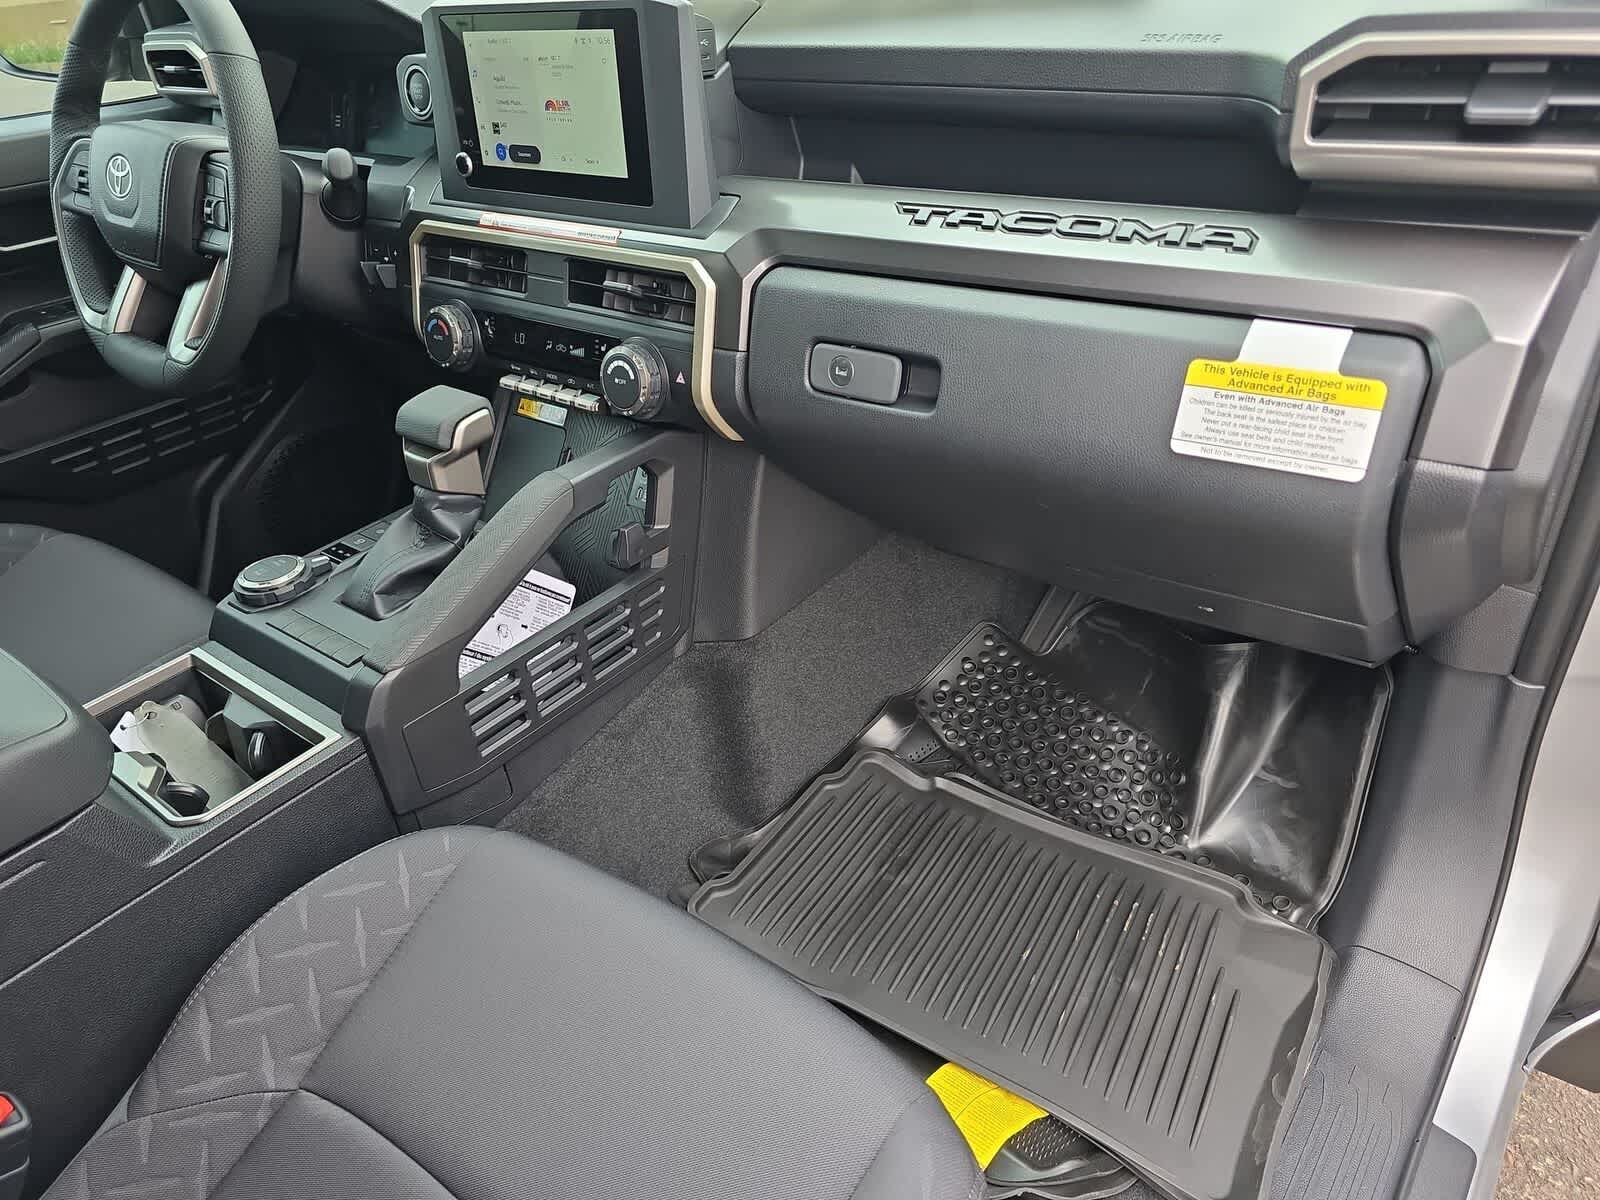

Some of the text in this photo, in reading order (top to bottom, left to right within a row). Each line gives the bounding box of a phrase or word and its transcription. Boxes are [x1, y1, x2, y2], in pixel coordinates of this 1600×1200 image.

[895, 201, 1260, 255] TACOMA
[1203, 363, 1371, 393] This Vehicle is Equipped with
[1227, 378, 1337, 402] Advanced Air Bags
[1213, 391, 1346, 417] Even with Advanced Air Bags
[1239, 404, 1255, 412] killed
[1200, 416, 1219, 424] Never
[1220, 419, 1231, 427] put
[1238, 422, 1272, 433] rear-facing
[1273, 427, 1290, 435] child
[1216, 409, 1231, 417] back
[1232, 411, 1247, 419] seat
[1288, 419, 1307, 429] place
[1204, 426, 1225, 435] Always
[1255, 433, 1271, 441] belts
[1286, 438, 1303, 446] child
[1218, 437, 1242, 445] manual
[1253, 442, 1270, 450] more
[1271, 445, 1308, 456] information
[1310, 451, 1328, 459] about
[1234, 452, 1266, 462] removed
[1267, 457, 1292, 467] except
